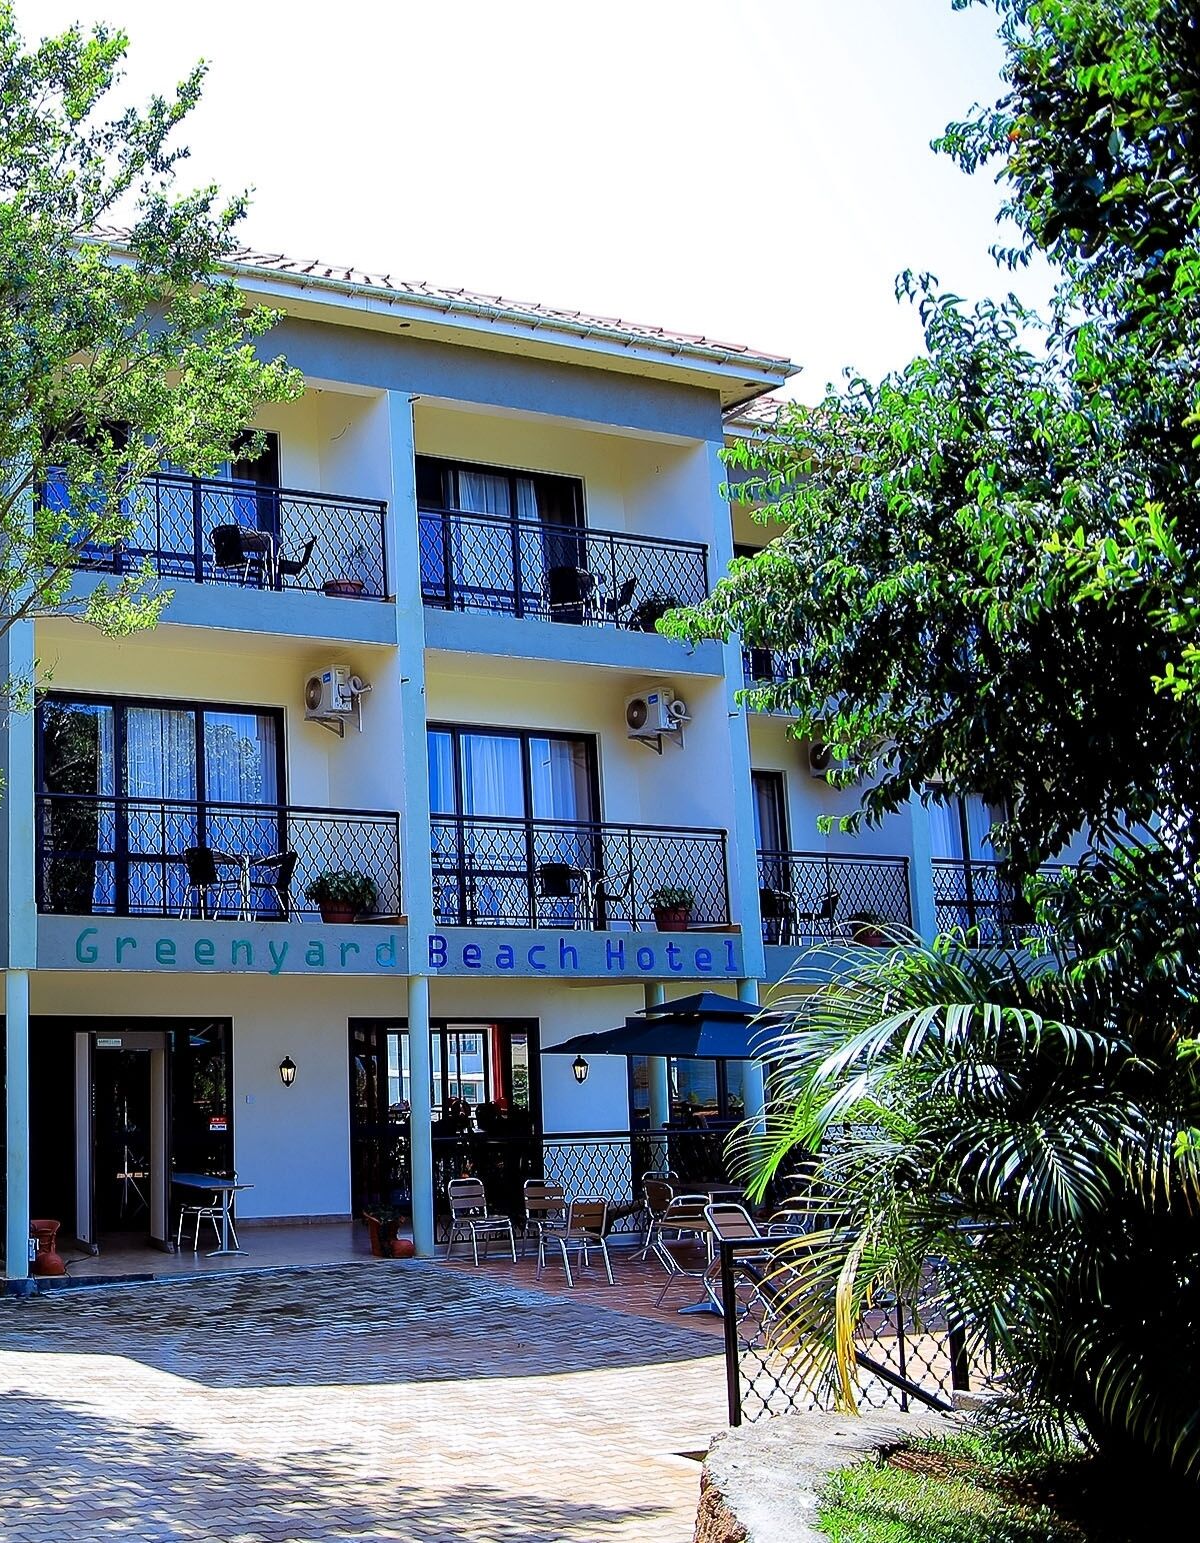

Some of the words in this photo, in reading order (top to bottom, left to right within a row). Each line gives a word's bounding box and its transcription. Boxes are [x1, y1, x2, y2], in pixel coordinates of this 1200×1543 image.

[75, 927, 397, 975] Greenyard
[427, 935, 578, 970] Beach
[606, 938, 738, 972] Hotel
